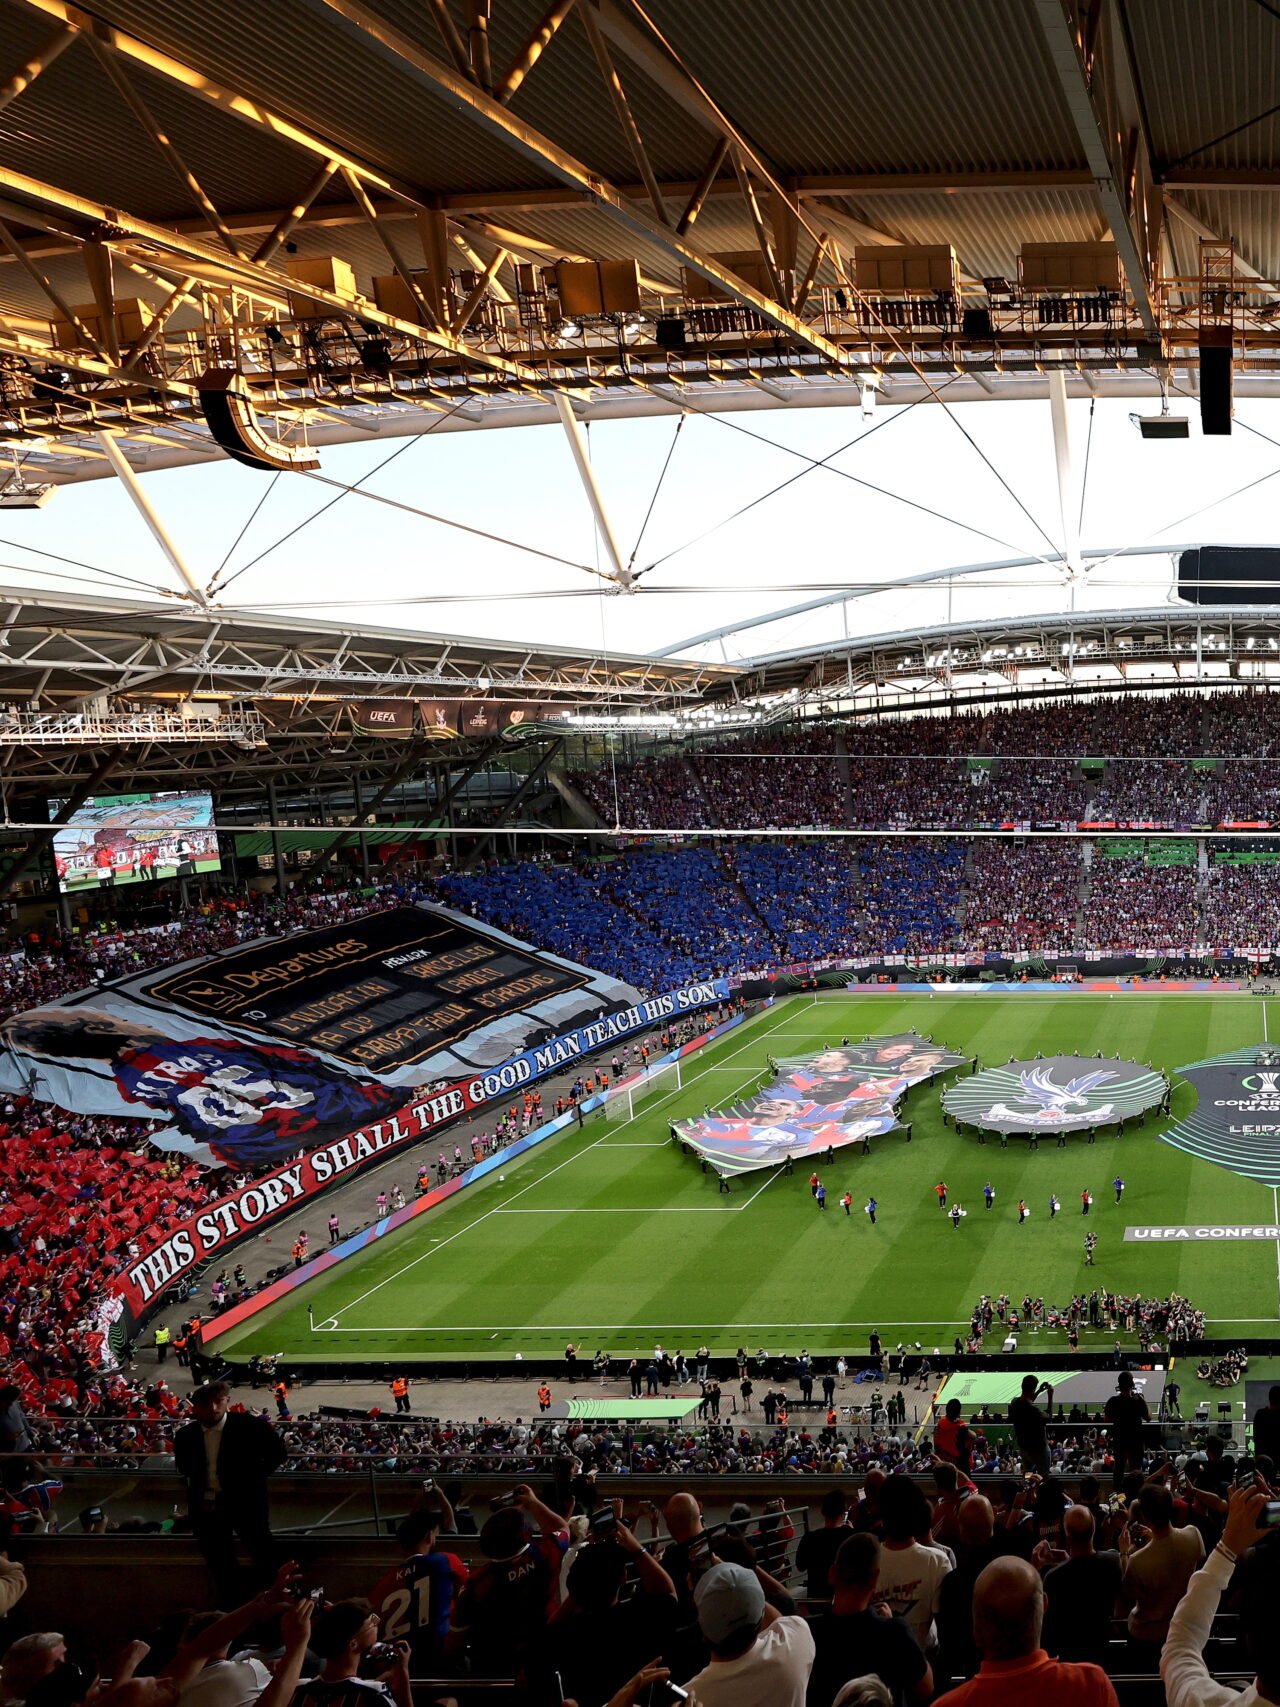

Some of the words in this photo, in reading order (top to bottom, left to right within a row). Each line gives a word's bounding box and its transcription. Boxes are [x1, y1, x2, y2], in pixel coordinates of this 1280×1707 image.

[369, 710, 397, 722] UEFA
[223, 938, 368, 989] Departures
[381, 948, 431, 969] REMARK
[438, 967, 505, 994] LANDED
[240, 1009, 268, 1021] TO
[311, 1030, 348, 1047] FA
[129, 1231, 195, 1301] THIS
[197, 1165, 304, 1248] STORY
[311, 1117, 409, 1182] SHALL
[412, 1089, 465, 1130] THE
[469, 1057, 532, 1103] GOOD
[534, 1032, 582, 1073] MAN
[584, 1006, 643, 1047] TEACH
[646, 994, 674, 1021] HIS
[677, 981, 723, 1009] SON.
[1134, 1228, 1190, 1238] UEFA
[395, 1564, 417, 1581] KAI
[507, 1560, 536, 1583] DAN
[380, 1575, 431, 1643] 21
